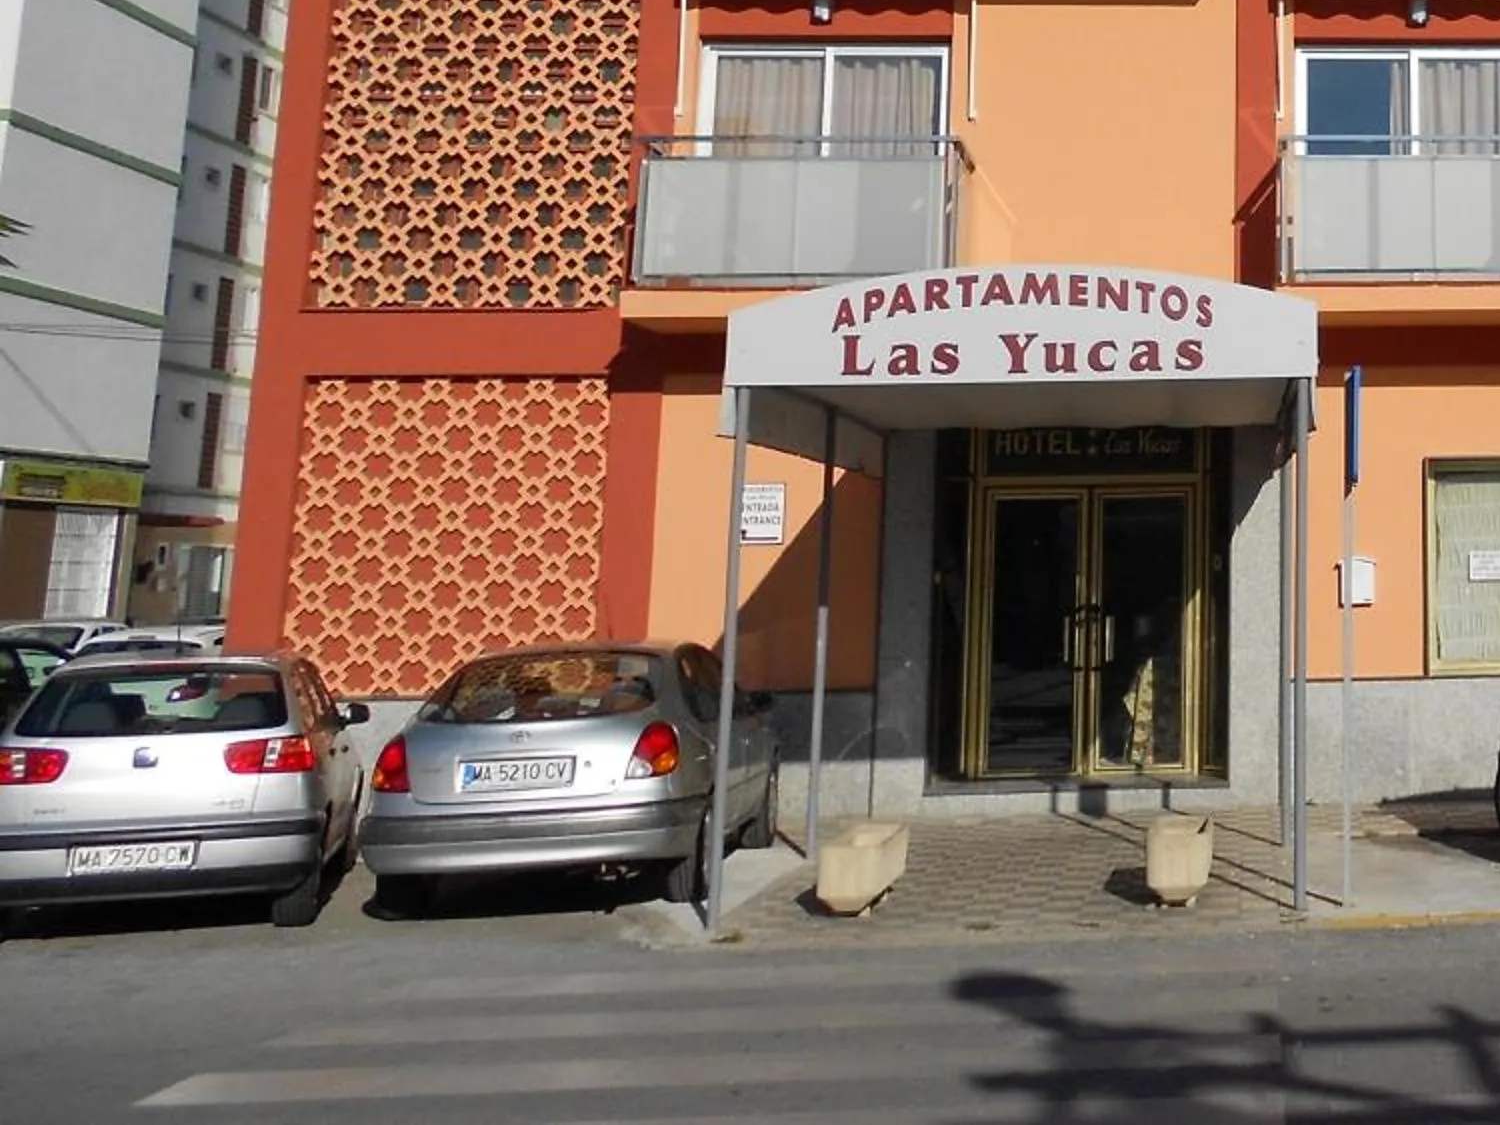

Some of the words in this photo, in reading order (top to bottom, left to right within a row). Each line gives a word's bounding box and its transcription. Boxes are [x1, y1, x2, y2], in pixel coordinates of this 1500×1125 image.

[831, 272, 1213, 333] APARTAMENTOS
[840, 334, 960, 376] Las
[998, 332, 1204, 374] Yucas
[994, 429, 1080, 455] HOTEL
[746, 502, 779, 512] NTRADA
[743, 516, 780, 524] NTRANCE
[498, 761, 541, 781] 5210
[544, 761, 567, 778] CV
[108, 847, 159, 866] 7570
[165, 844, 190, 863] CW
